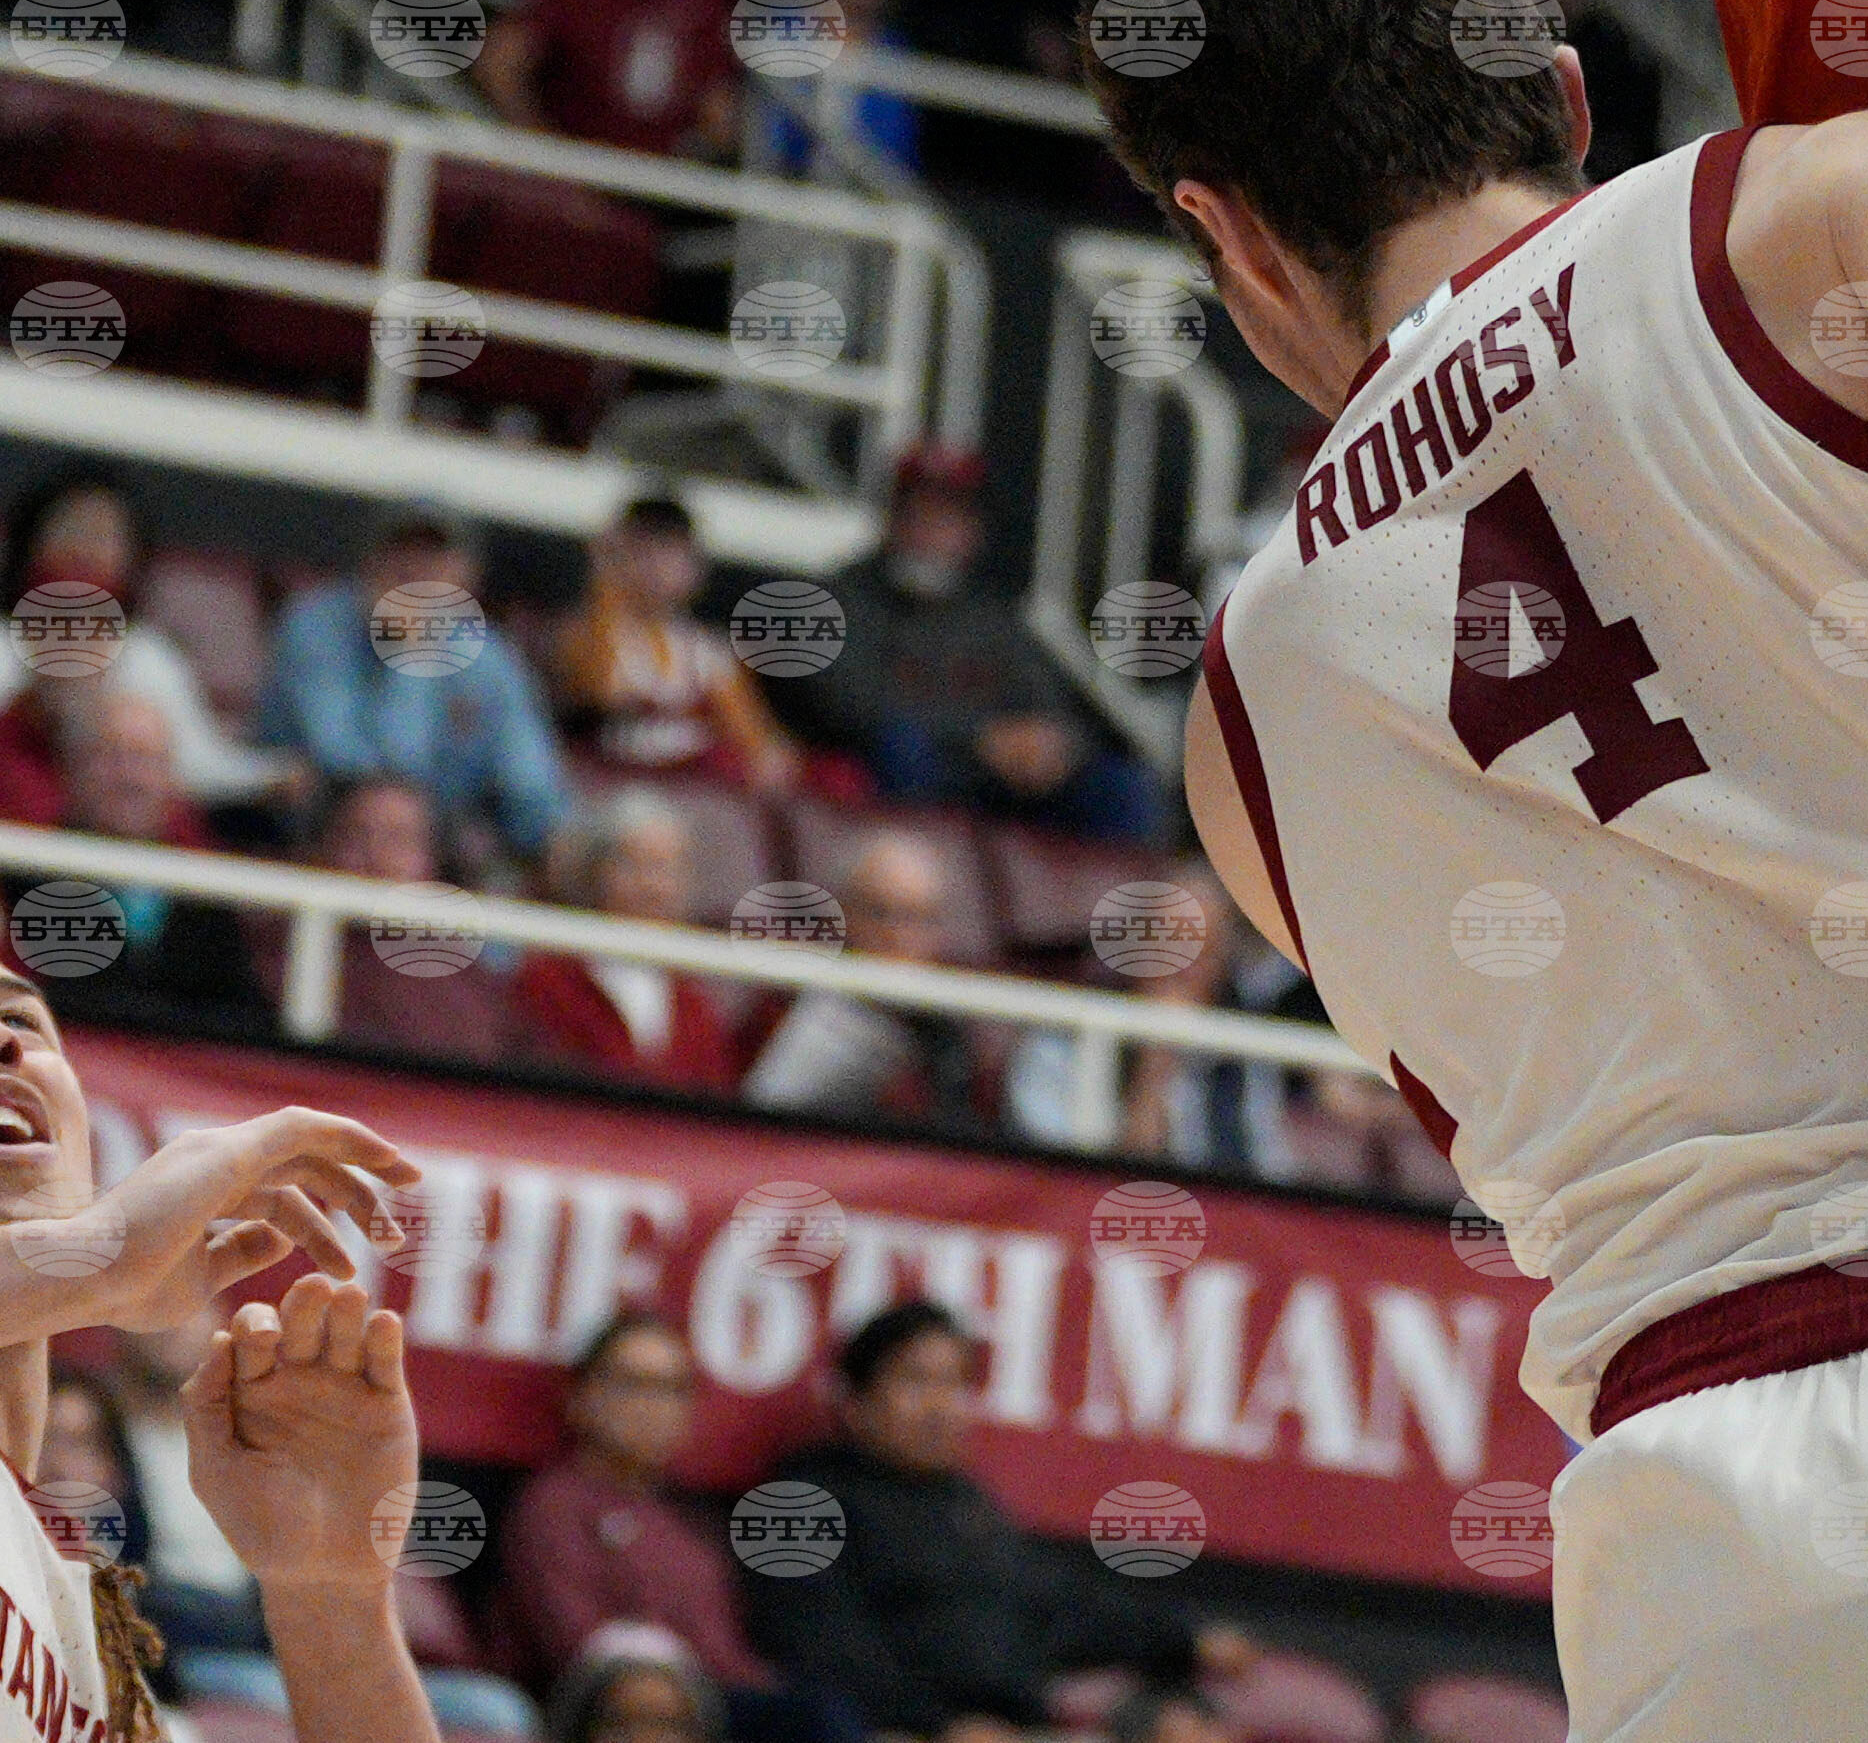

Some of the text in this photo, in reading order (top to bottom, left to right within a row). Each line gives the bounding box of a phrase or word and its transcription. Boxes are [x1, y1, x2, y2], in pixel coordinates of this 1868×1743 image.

[1295, 261, 1577, 567] ROHOSY
[1448, 467, 1711, 825] 4
[1076, 1254, 1505, 1488] MAN
